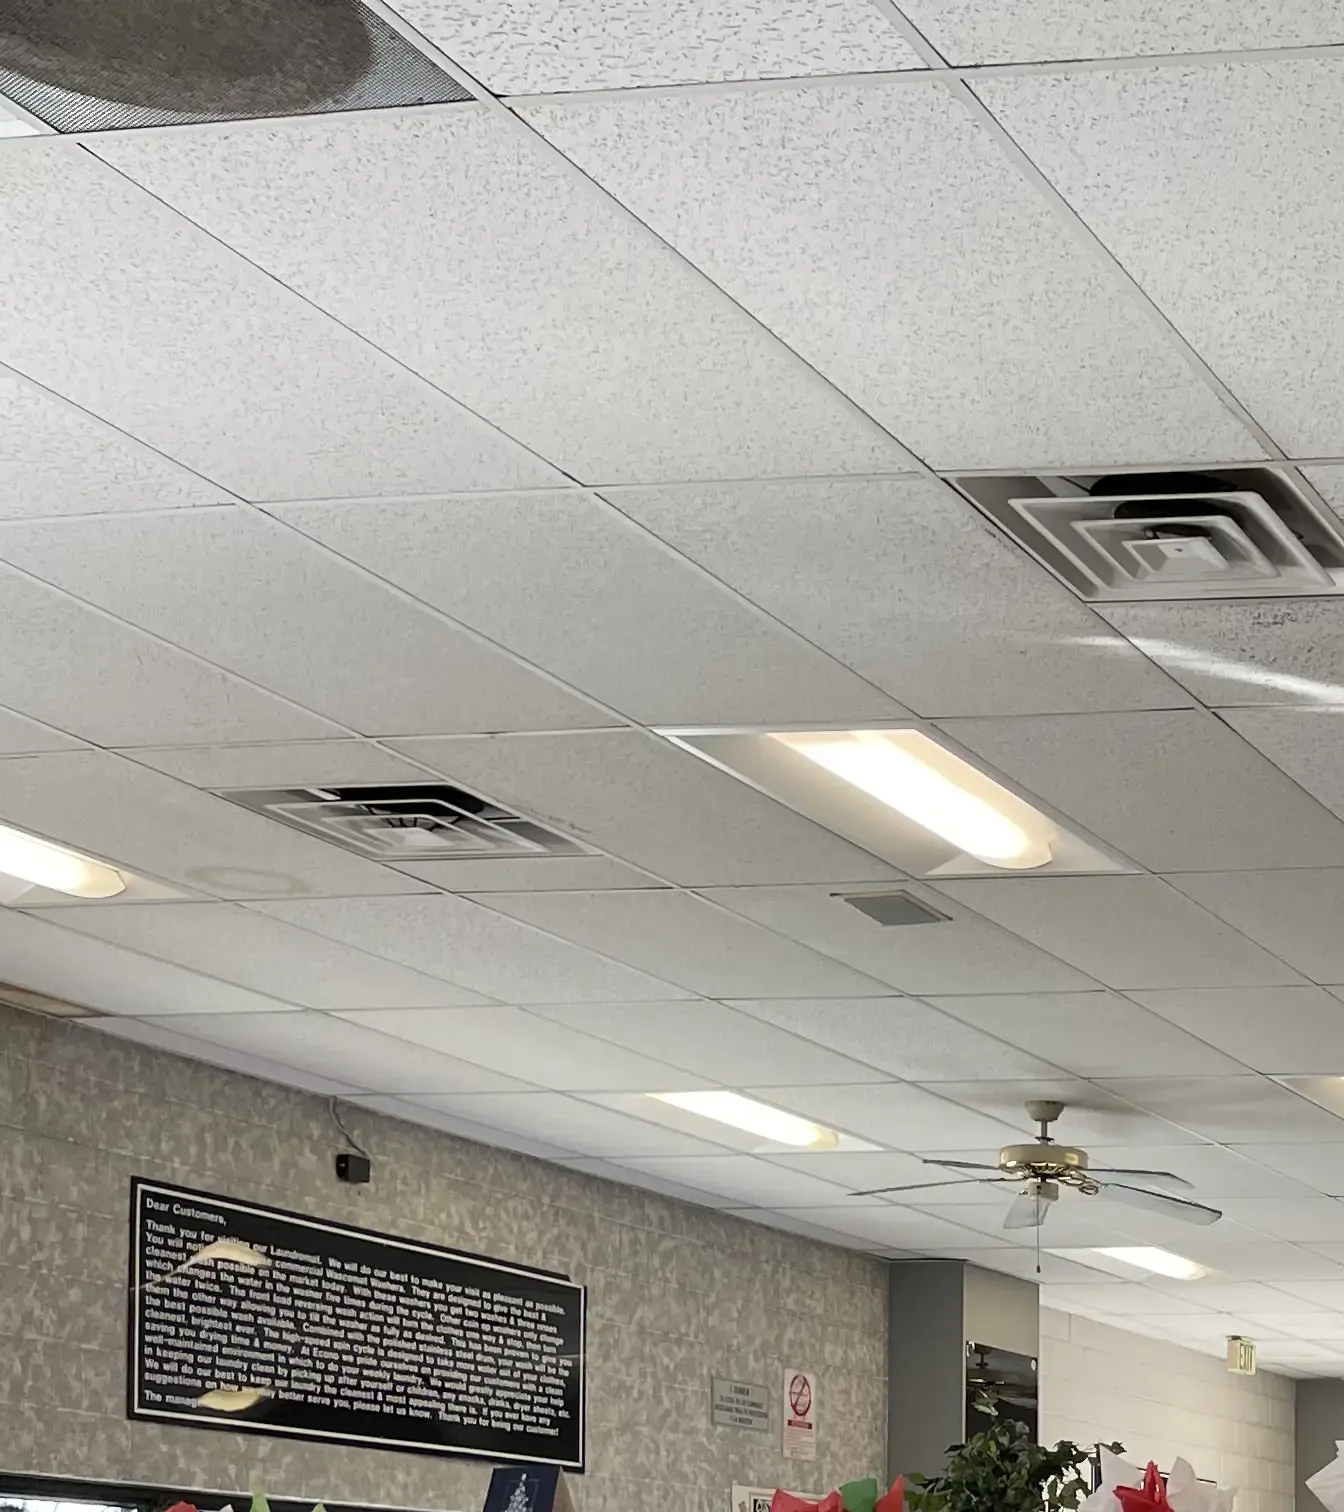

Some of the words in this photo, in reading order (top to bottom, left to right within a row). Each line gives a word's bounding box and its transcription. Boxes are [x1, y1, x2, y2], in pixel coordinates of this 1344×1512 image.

[146, 1198, 170, 1212] Dear
[146, 1219, 176, 1235] Thank
[180, 1228, 198, 1239] you
